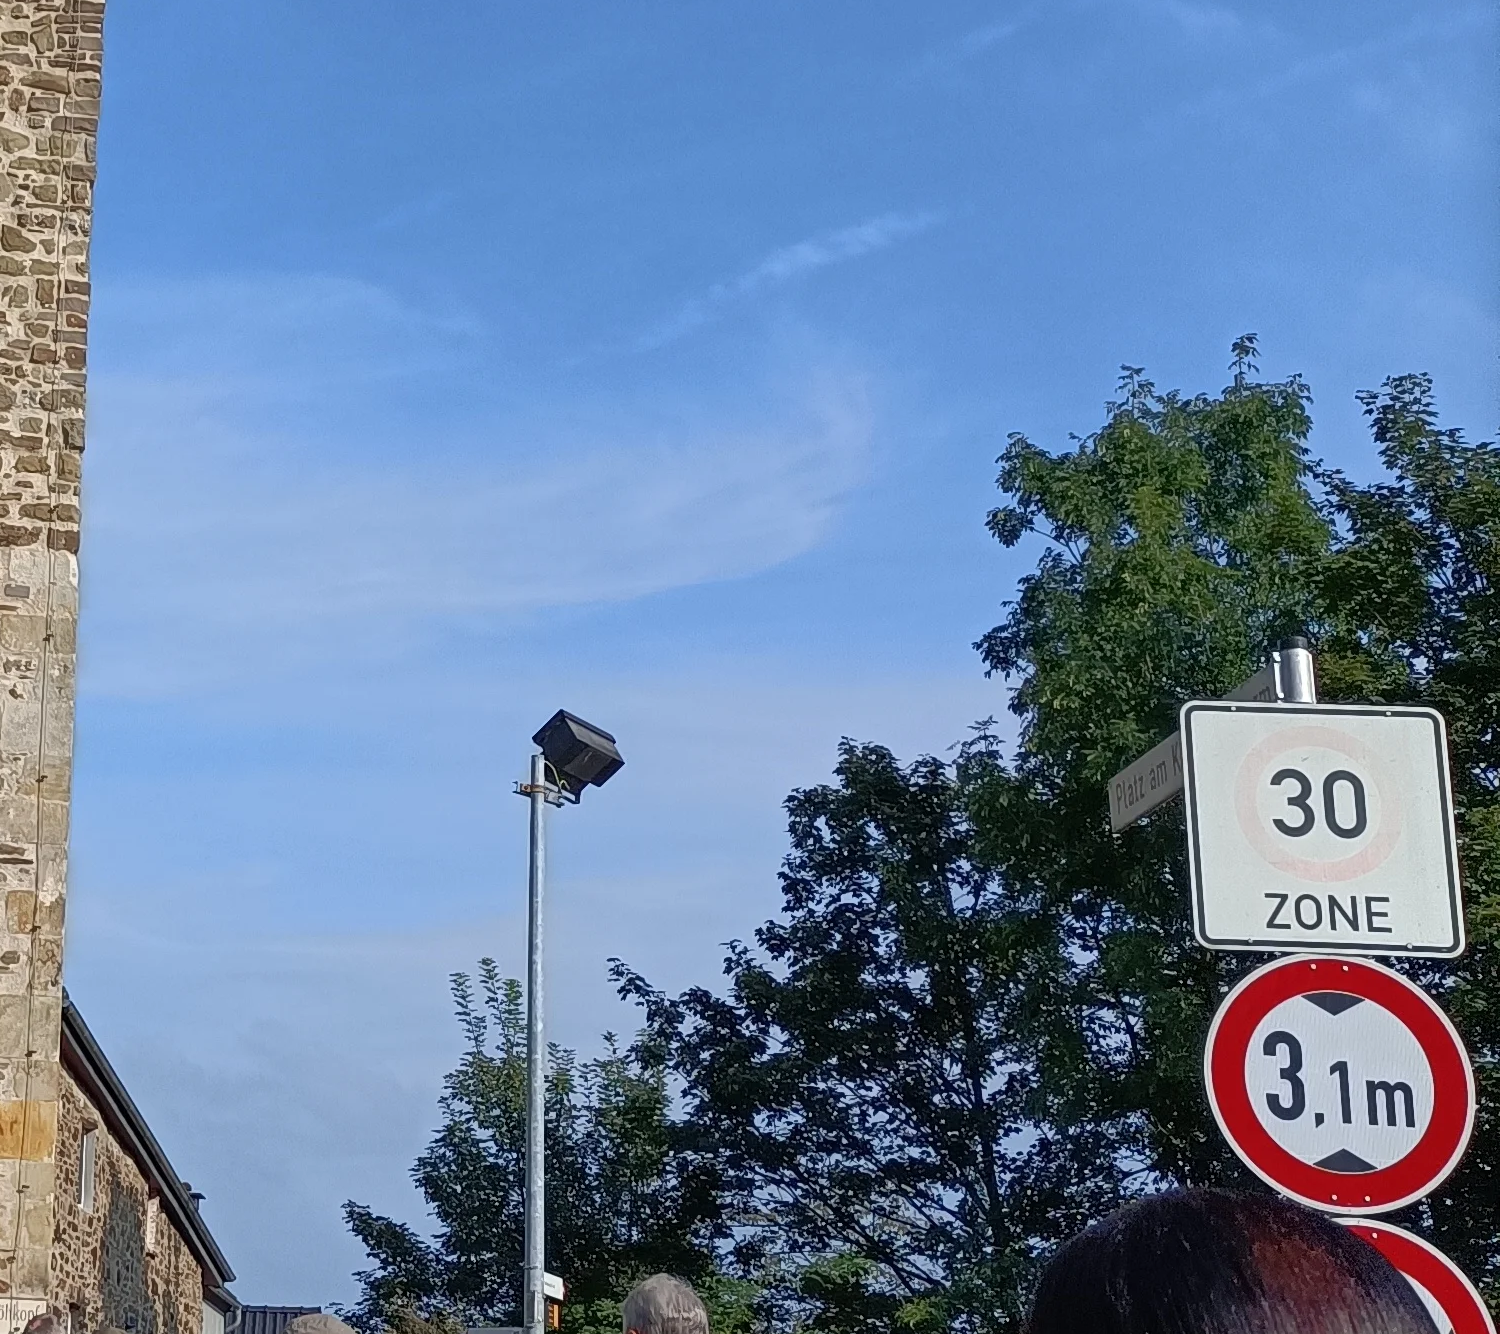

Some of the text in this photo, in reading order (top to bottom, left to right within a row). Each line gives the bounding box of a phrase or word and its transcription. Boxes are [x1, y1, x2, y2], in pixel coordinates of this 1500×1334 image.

[1115, 774, 1145, 816] Platz
[1151, 760, 1168, 792] am
[1269, 768, 1368, 840] 30
[1264, 892, 1393, 934] ZONE
